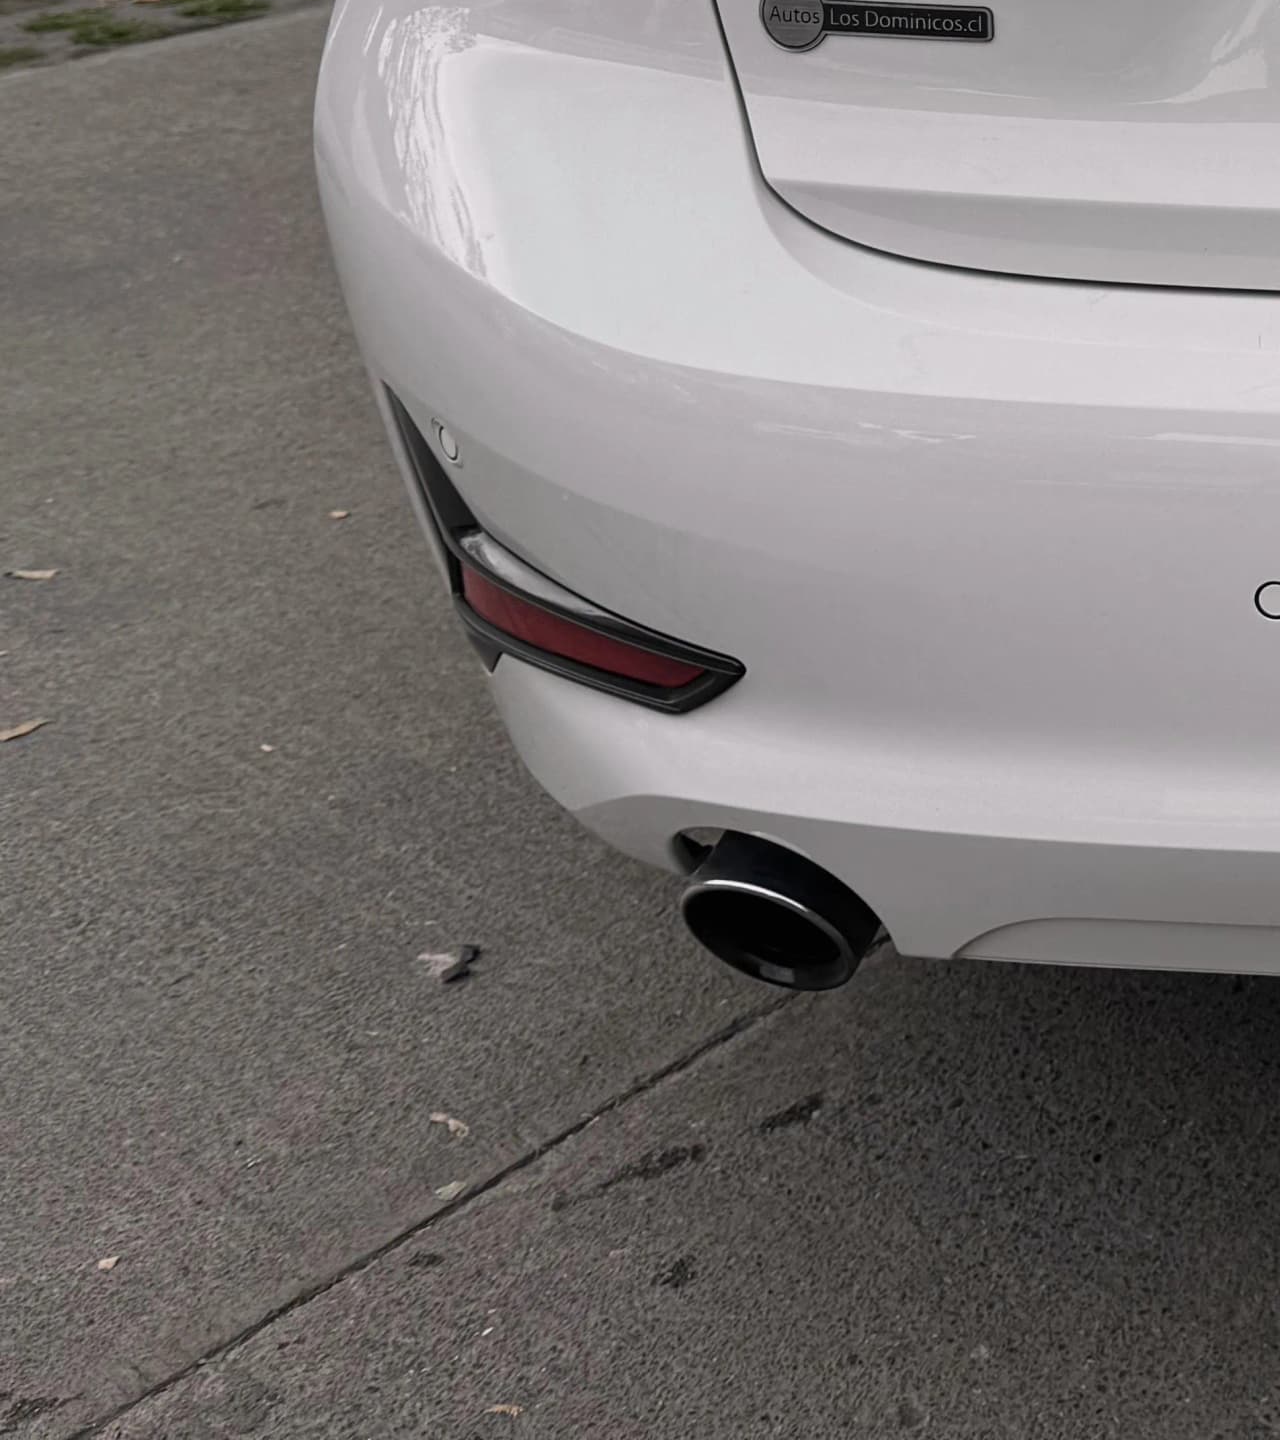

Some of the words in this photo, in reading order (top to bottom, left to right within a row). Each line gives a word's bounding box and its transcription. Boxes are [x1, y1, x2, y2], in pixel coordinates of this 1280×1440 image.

[769, 6, 820, 25] Autos
[830, 8, 860, 27] Los
[865, 11, 982, 33] Dominicos.cl
